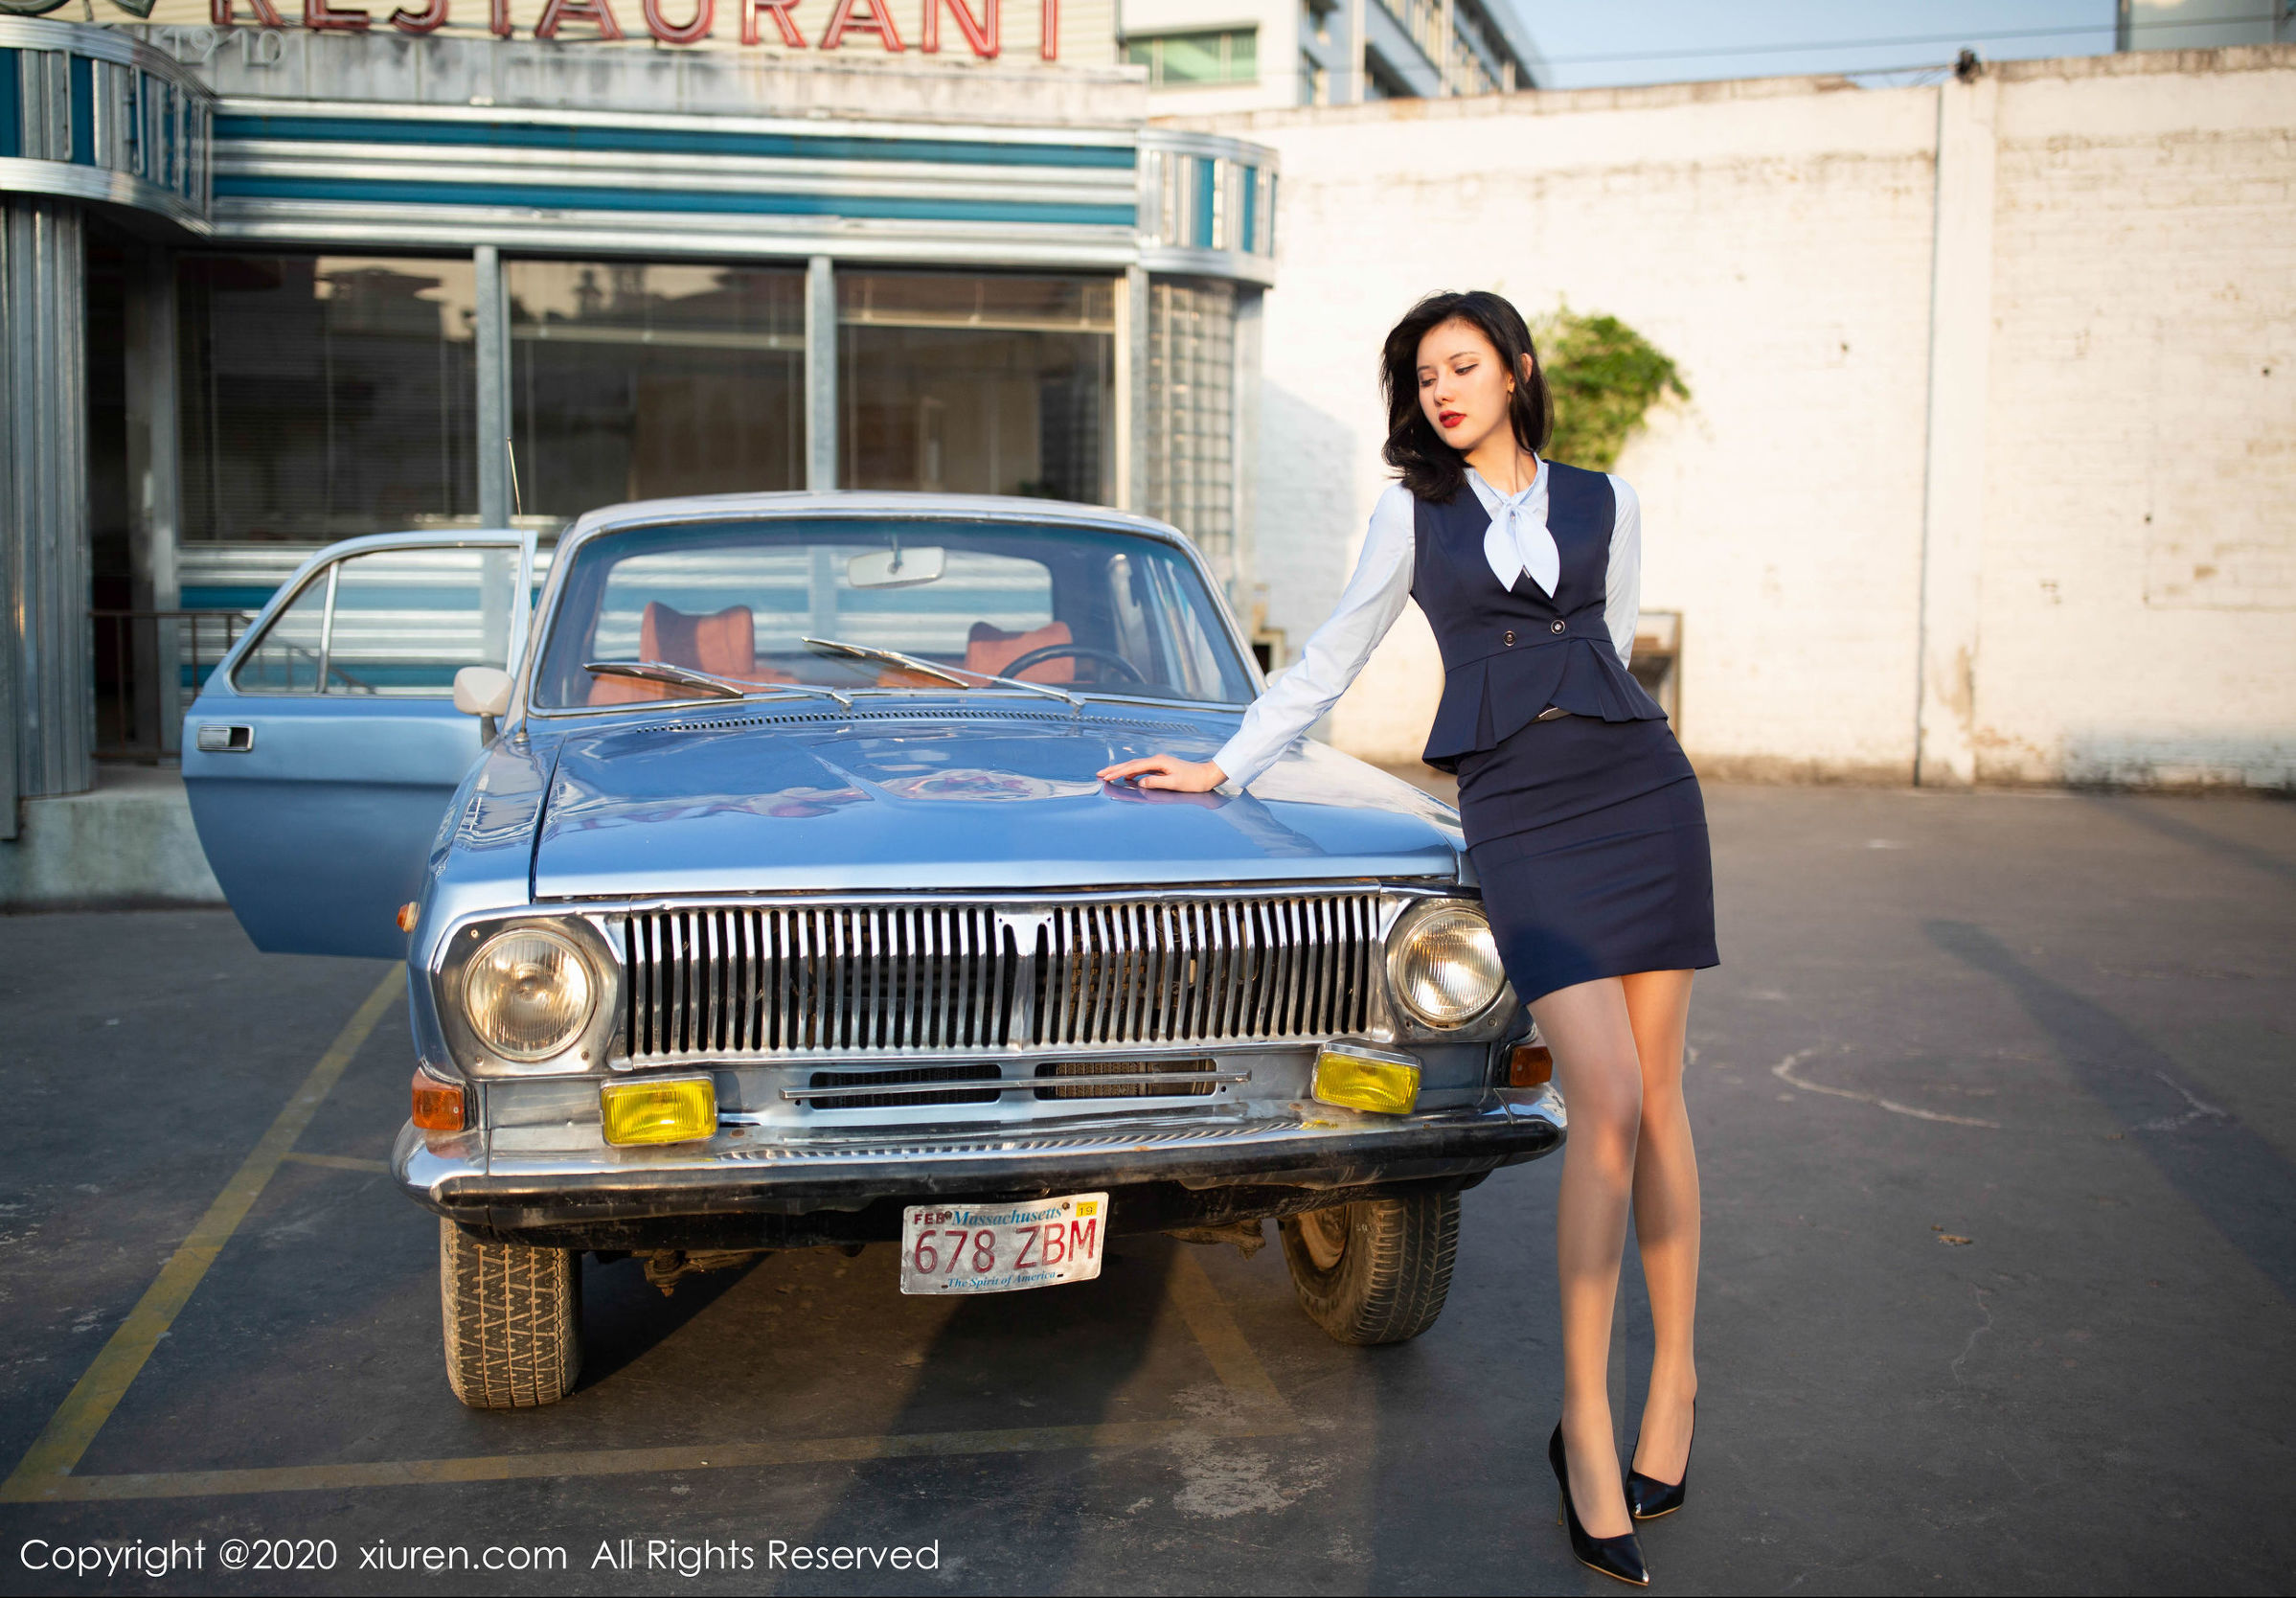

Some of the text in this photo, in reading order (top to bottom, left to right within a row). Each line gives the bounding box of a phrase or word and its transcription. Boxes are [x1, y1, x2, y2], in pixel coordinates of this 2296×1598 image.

[914, 1212, 946, 1225] FEB
[951, 1207, 1062, 1226] Massachusetts
[1080, 1205, 1093, 1216] 19
[915, 1218, 1097, 1274] 678 ZBM
[947, 1270, 1056, 1290] The Spirit of America
